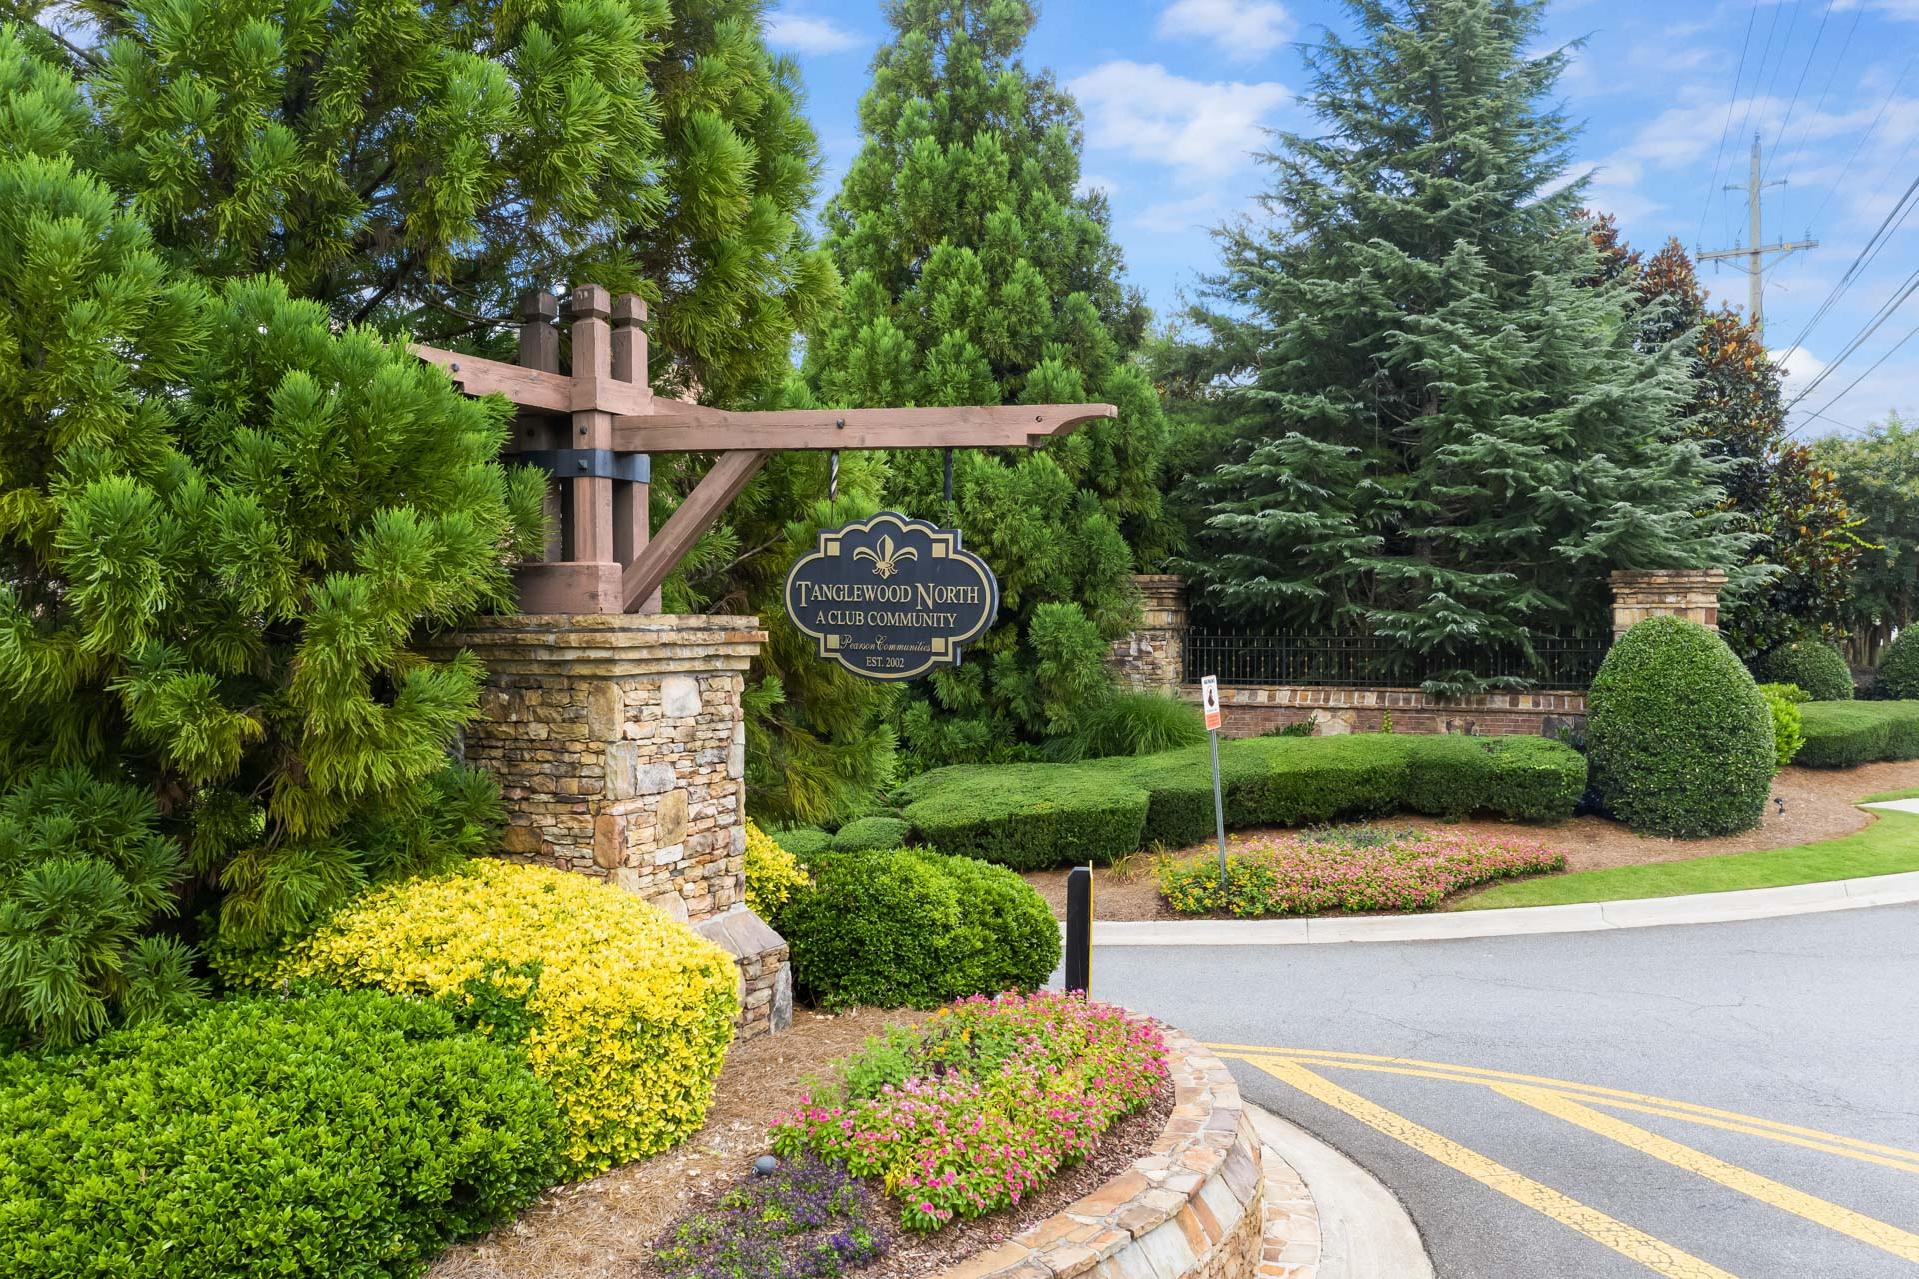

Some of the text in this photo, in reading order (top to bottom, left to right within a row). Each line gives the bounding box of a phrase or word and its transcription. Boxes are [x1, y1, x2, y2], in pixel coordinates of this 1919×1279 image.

[796, 581, 979, 610] TANGLEWOOD NORTH
[816, 611, 957, 627] A CLUB COMMUNITY
[840, 634, 931, 652] Pearson Communities
[866, 656, 904, 668] EST. 2002
